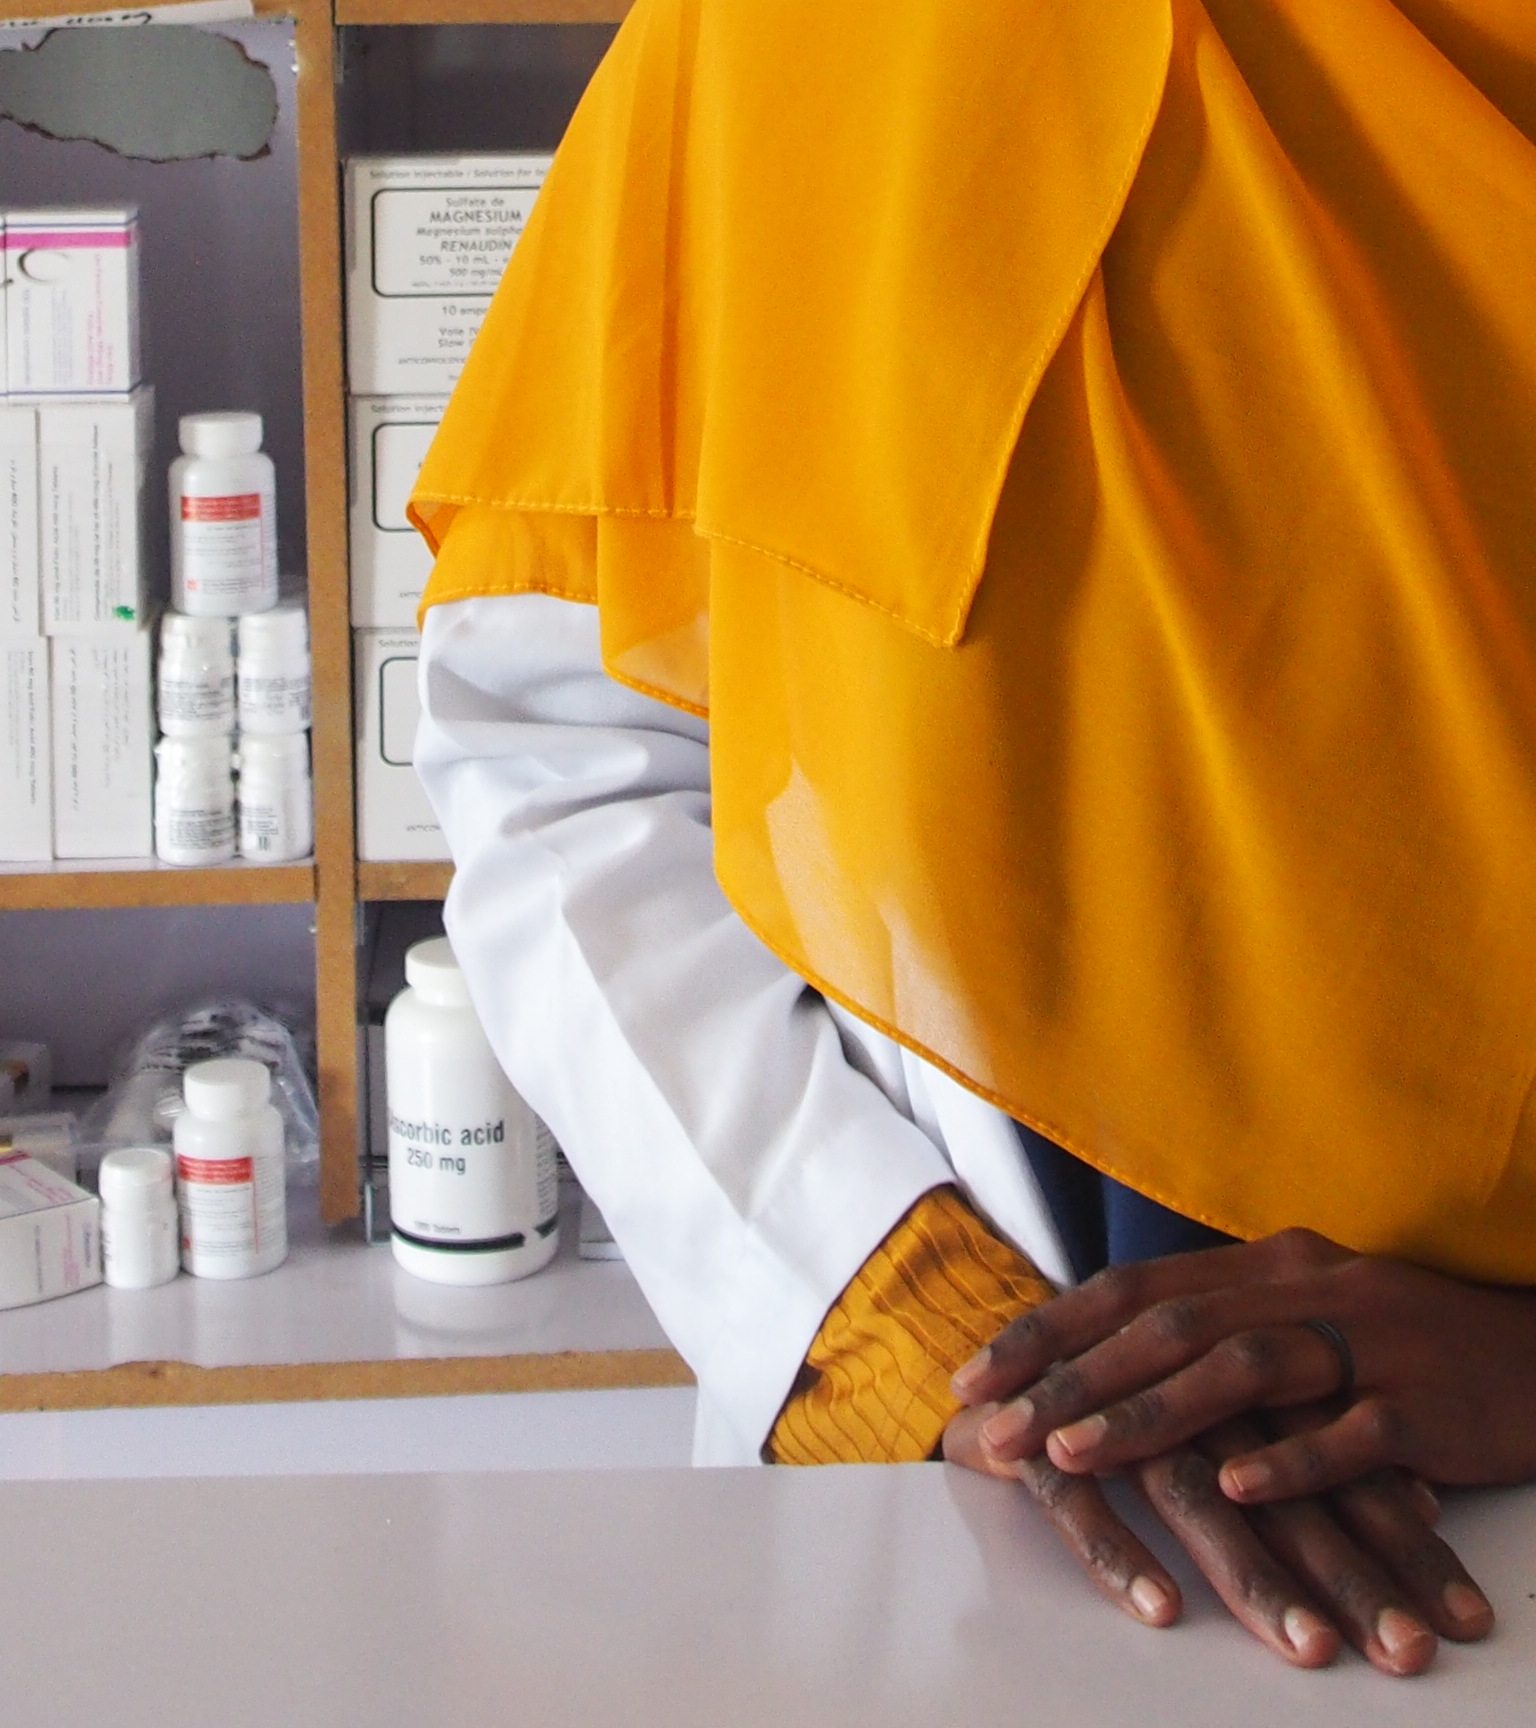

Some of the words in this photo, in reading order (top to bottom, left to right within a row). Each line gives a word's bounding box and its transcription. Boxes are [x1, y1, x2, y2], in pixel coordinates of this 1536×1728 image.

[430, 211, 522, 223] MAGNESIUM
[441, 240, 511, 252] RENAUDIN
[461, 1120, 505, 1146] acid
[408, 1148, 433, 1170] 250
[440, 1155, 467, 1175] mg
